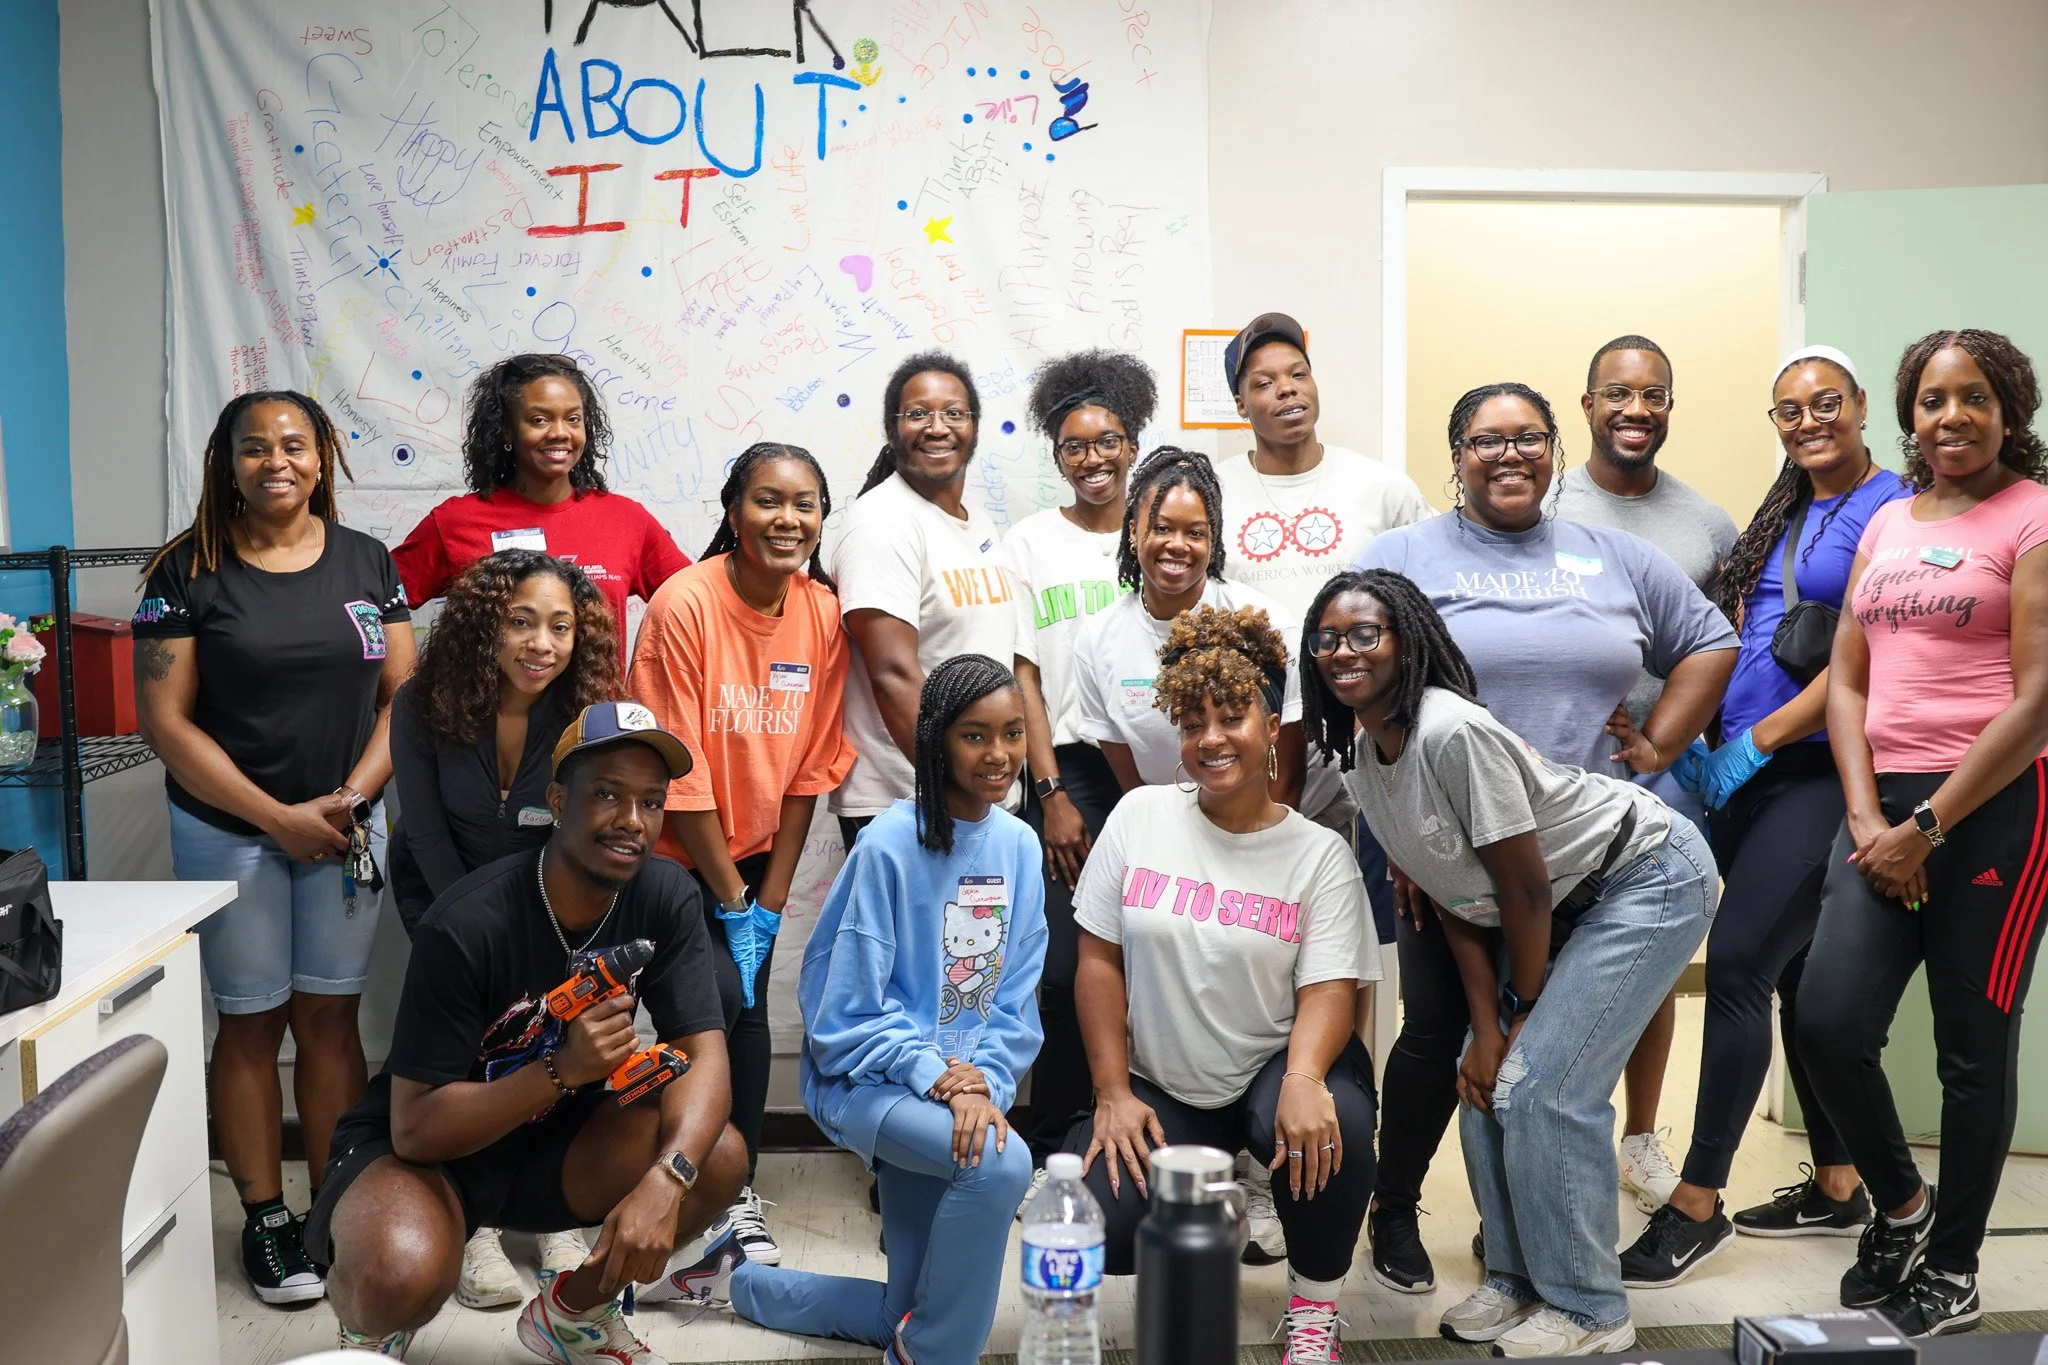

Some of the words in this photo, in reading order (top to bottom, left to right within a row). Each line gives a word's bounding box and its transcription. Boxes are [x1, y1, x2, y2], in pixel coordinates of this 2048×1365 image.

[299, 26, 374, 56] Sweet
[529, 46, 861, 178] ABOUT
[975, 94, 1039, 126] Live
[256, 88, 294, 201] Gratitude
[478, 120, 564, 201] Empowerment
[958, 131, 998, 200] ABOUT
[357, 162, 383, 194] Love
[912, 134, 978, 217] Think
[722, 183, 757, 216] Self
[289, 233, 313, 292] Think
[441, 251, 500, 277] Family
[514, 251, 584, 278] Forever
[1067, 189, 1104, 314] Knowing
[422, 277, 472, 323] Happiness
[384, 285, 481, 379] Chilling
[599, 334, 651, 381] Health
[330, 387, 383, 448] Honesty
[942, 568, 983, 608] WE
[1079, 579, 1115, 615] TO
[1454, 571, 1539, 590] MADE
[1544, 567, 1581, 586] TO
[1855, 589, 1985, 634] verything
[718, 684, 773, 710] MADE
[780, 689, 805, 710] TO
[1172, 877, 1215, 922] TO
[1218, 889, 1301, 944] SERV
[620, 1083, 649, 1105] LITHIUM
